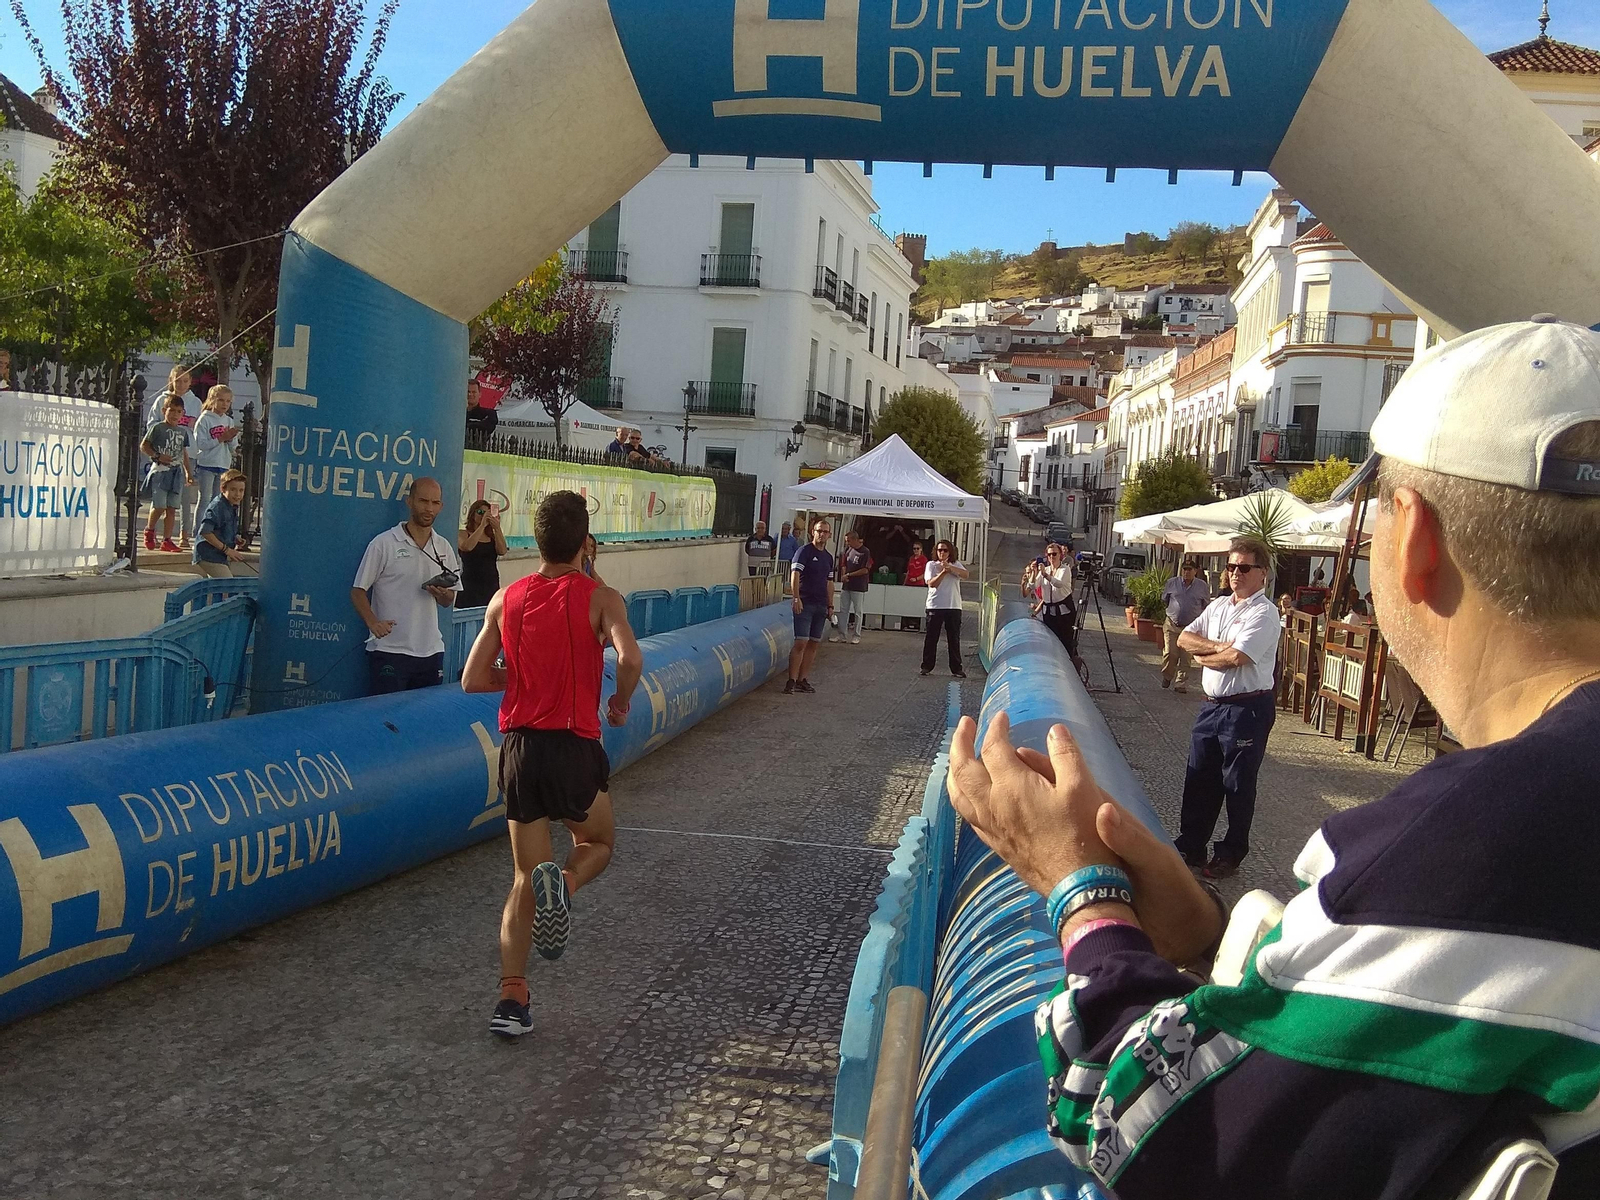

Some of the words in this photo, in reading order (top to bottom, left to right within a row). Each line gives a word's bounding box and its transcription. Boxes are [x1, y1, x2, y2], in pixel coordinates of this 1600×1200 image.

[888, 47, 961, 97] DE
[985, 45, 1231, 98] HUELVA
[0, 438, 102, 478] UTACIÓN
[285, 462, 415, 501] HUELVA
[0, 484, 90, 519] HUELVA
[829, 495, 862, 506] PATRONATO
[863, 497, 893, 507] MUNICIPAL
[896, 499, 905, 507] DE
[905, 499, 935, 509] DEPORTES
[288, 629, 300, 639] DE
[301, 631, 340, 642] HUELVA
[289, 619, 346, 633] DIPUTACIÓN
[118, 748, 354, 844] DIPUTACIÓN
[145, 850, 197, 918] DE
[211, 810, 342, 897] HUELVA
